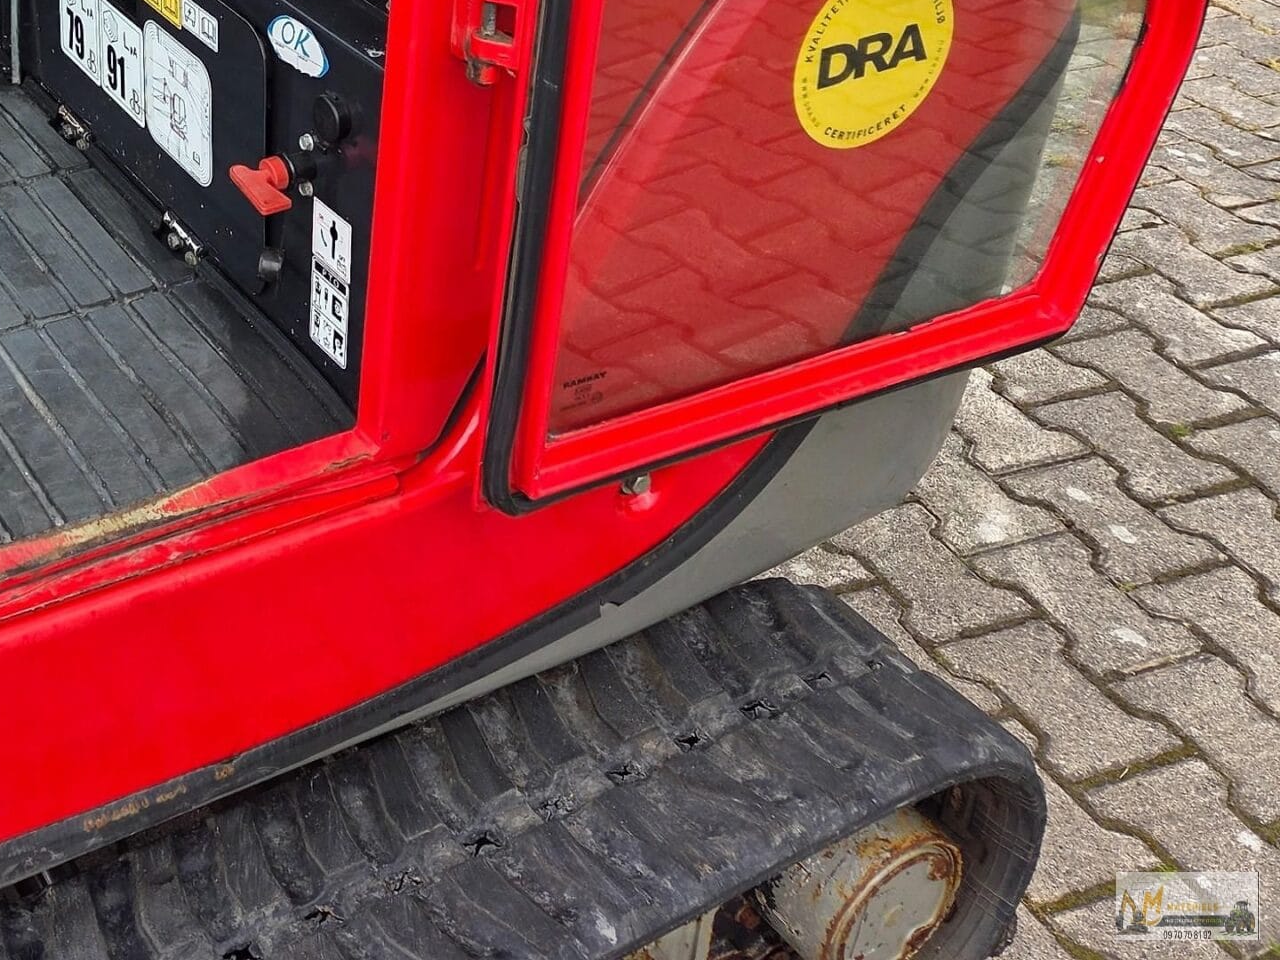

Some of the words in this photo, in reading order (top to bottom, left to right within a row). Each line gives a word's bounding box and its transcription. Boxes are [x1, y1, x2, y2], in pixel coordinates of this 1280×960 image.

[66, 6, 84, 60] 79
[282, 21, 310, 58] OK
[816, 23, 928, 91] DRA
[107, 43, 125, 100] 91
[824, 104, 906, 139] CERTIFICERET
